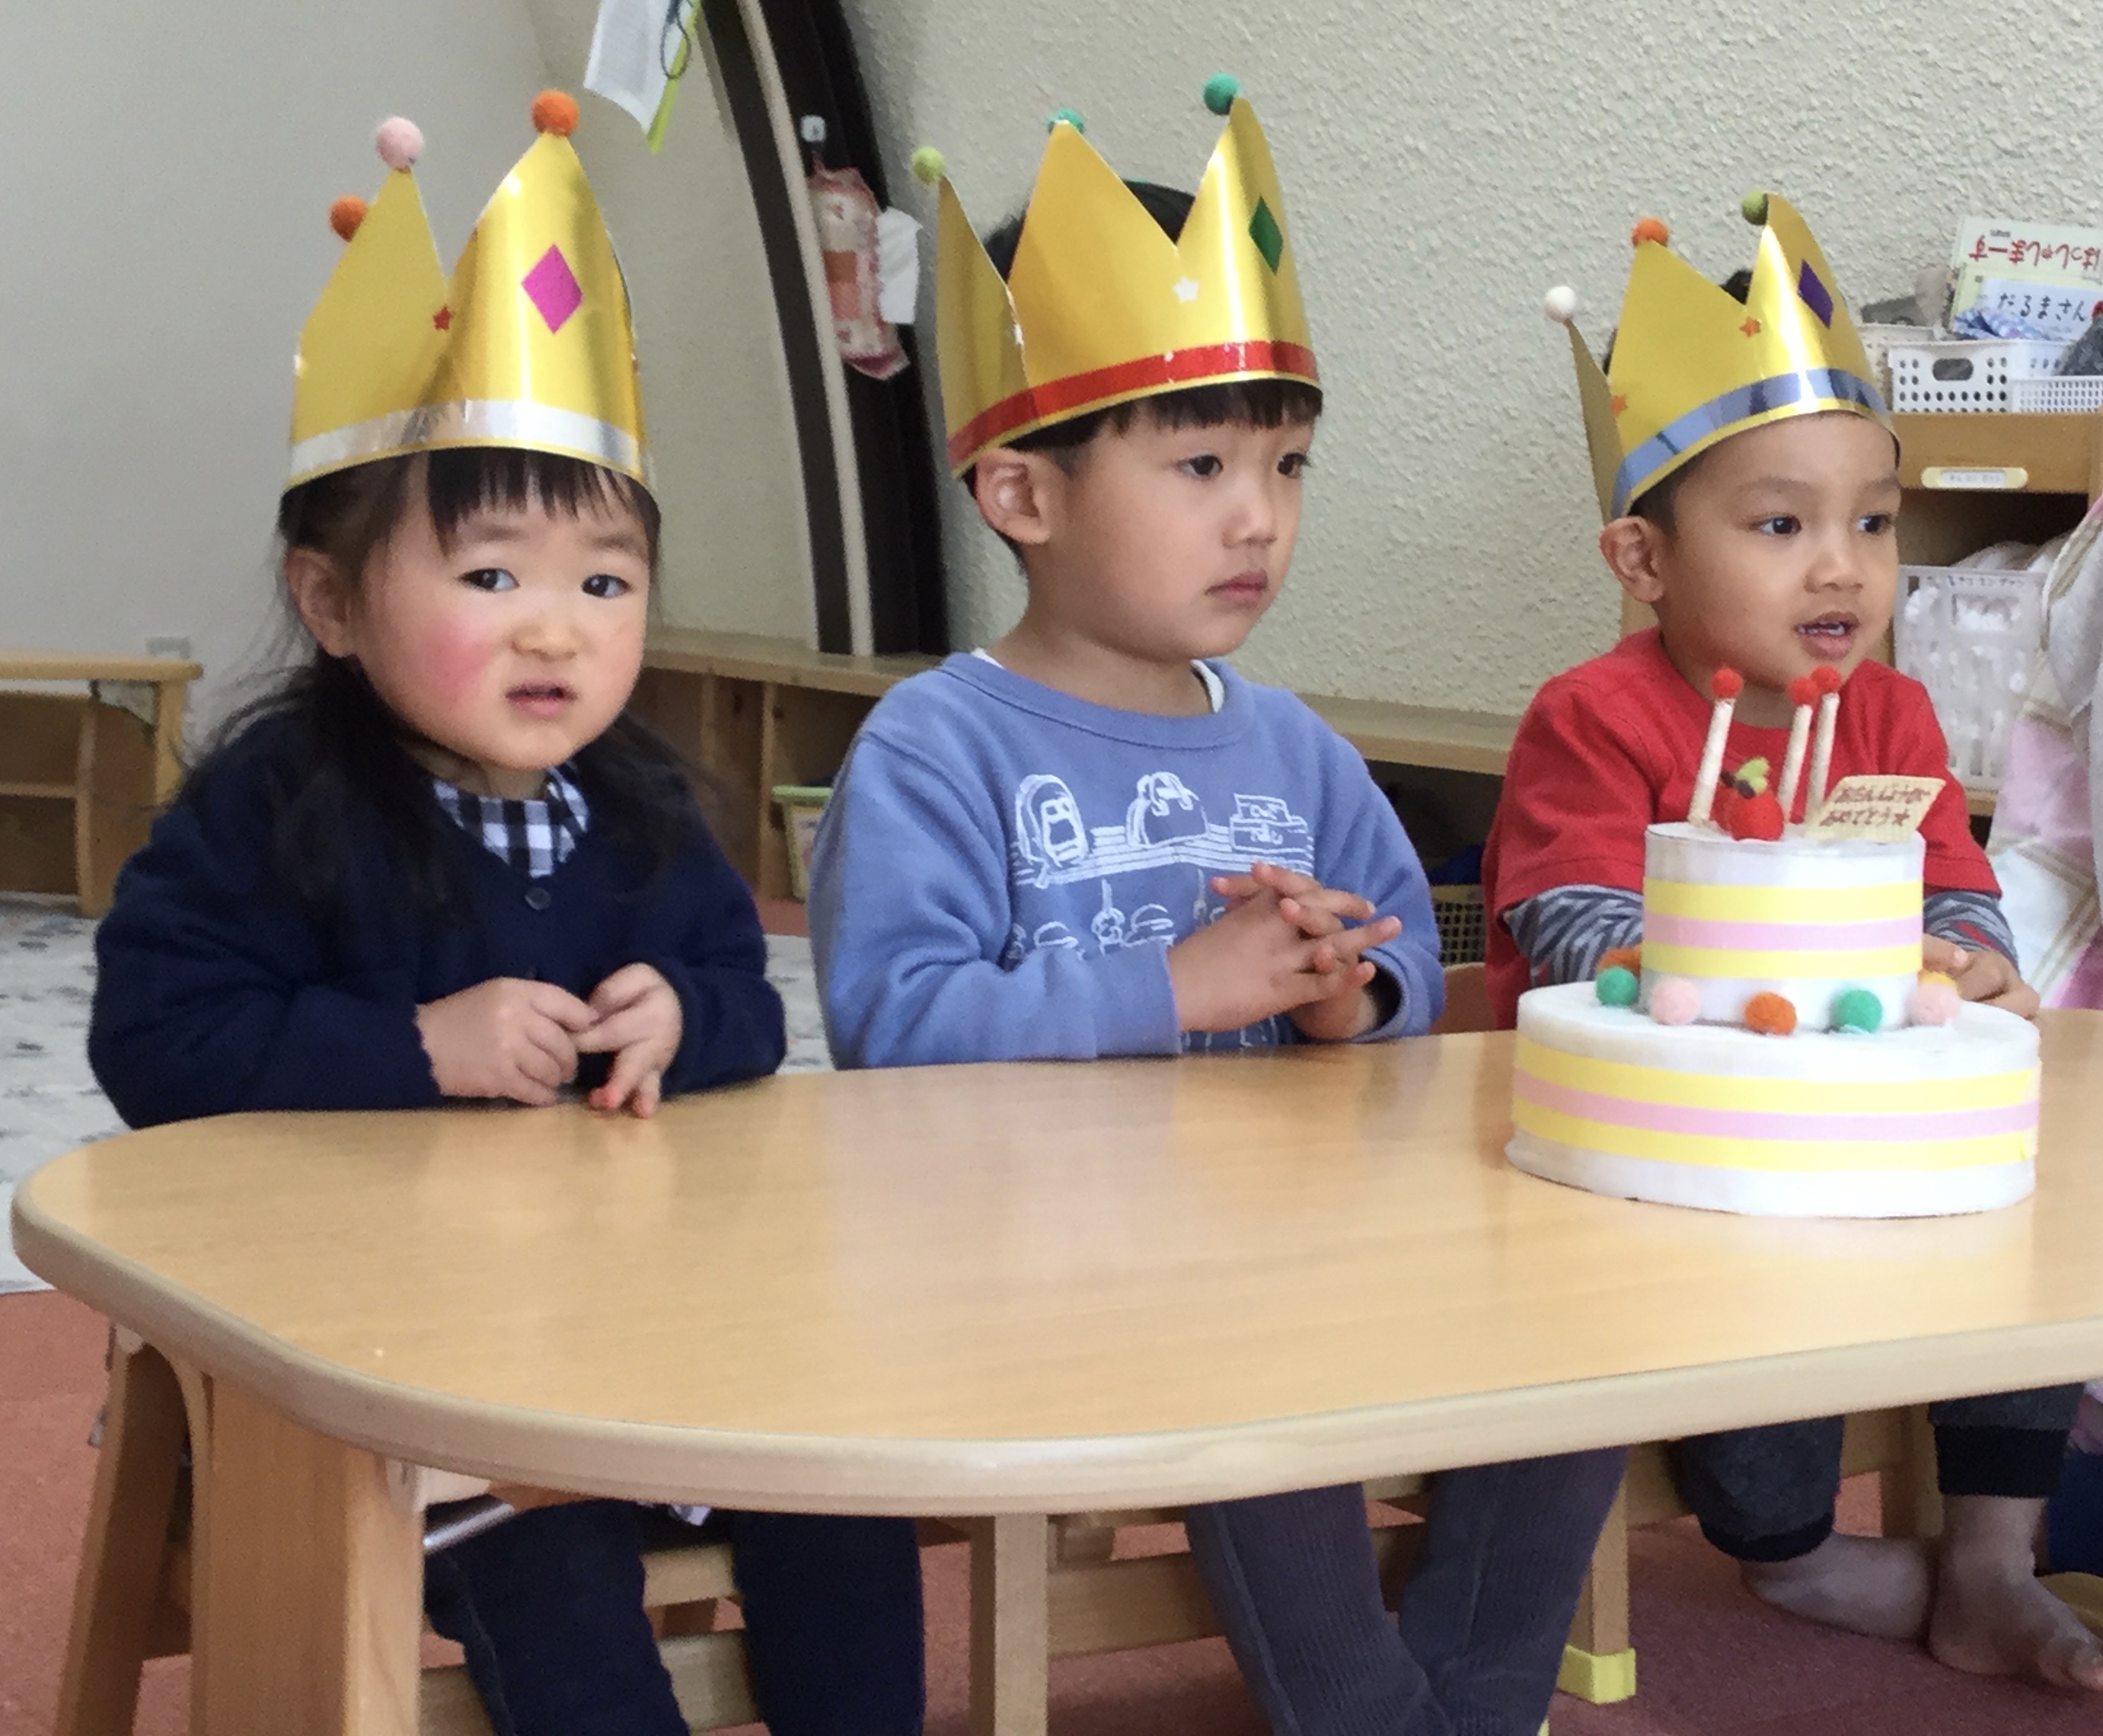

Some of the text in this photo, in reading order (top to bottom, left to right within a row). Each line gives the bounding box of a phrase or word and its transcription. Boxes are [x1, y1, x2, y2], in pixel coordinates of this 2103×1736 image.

[1968, 234, 2101, 270] はっしゃしまーす
[1998, 292, 2085, 321] だるまさん
